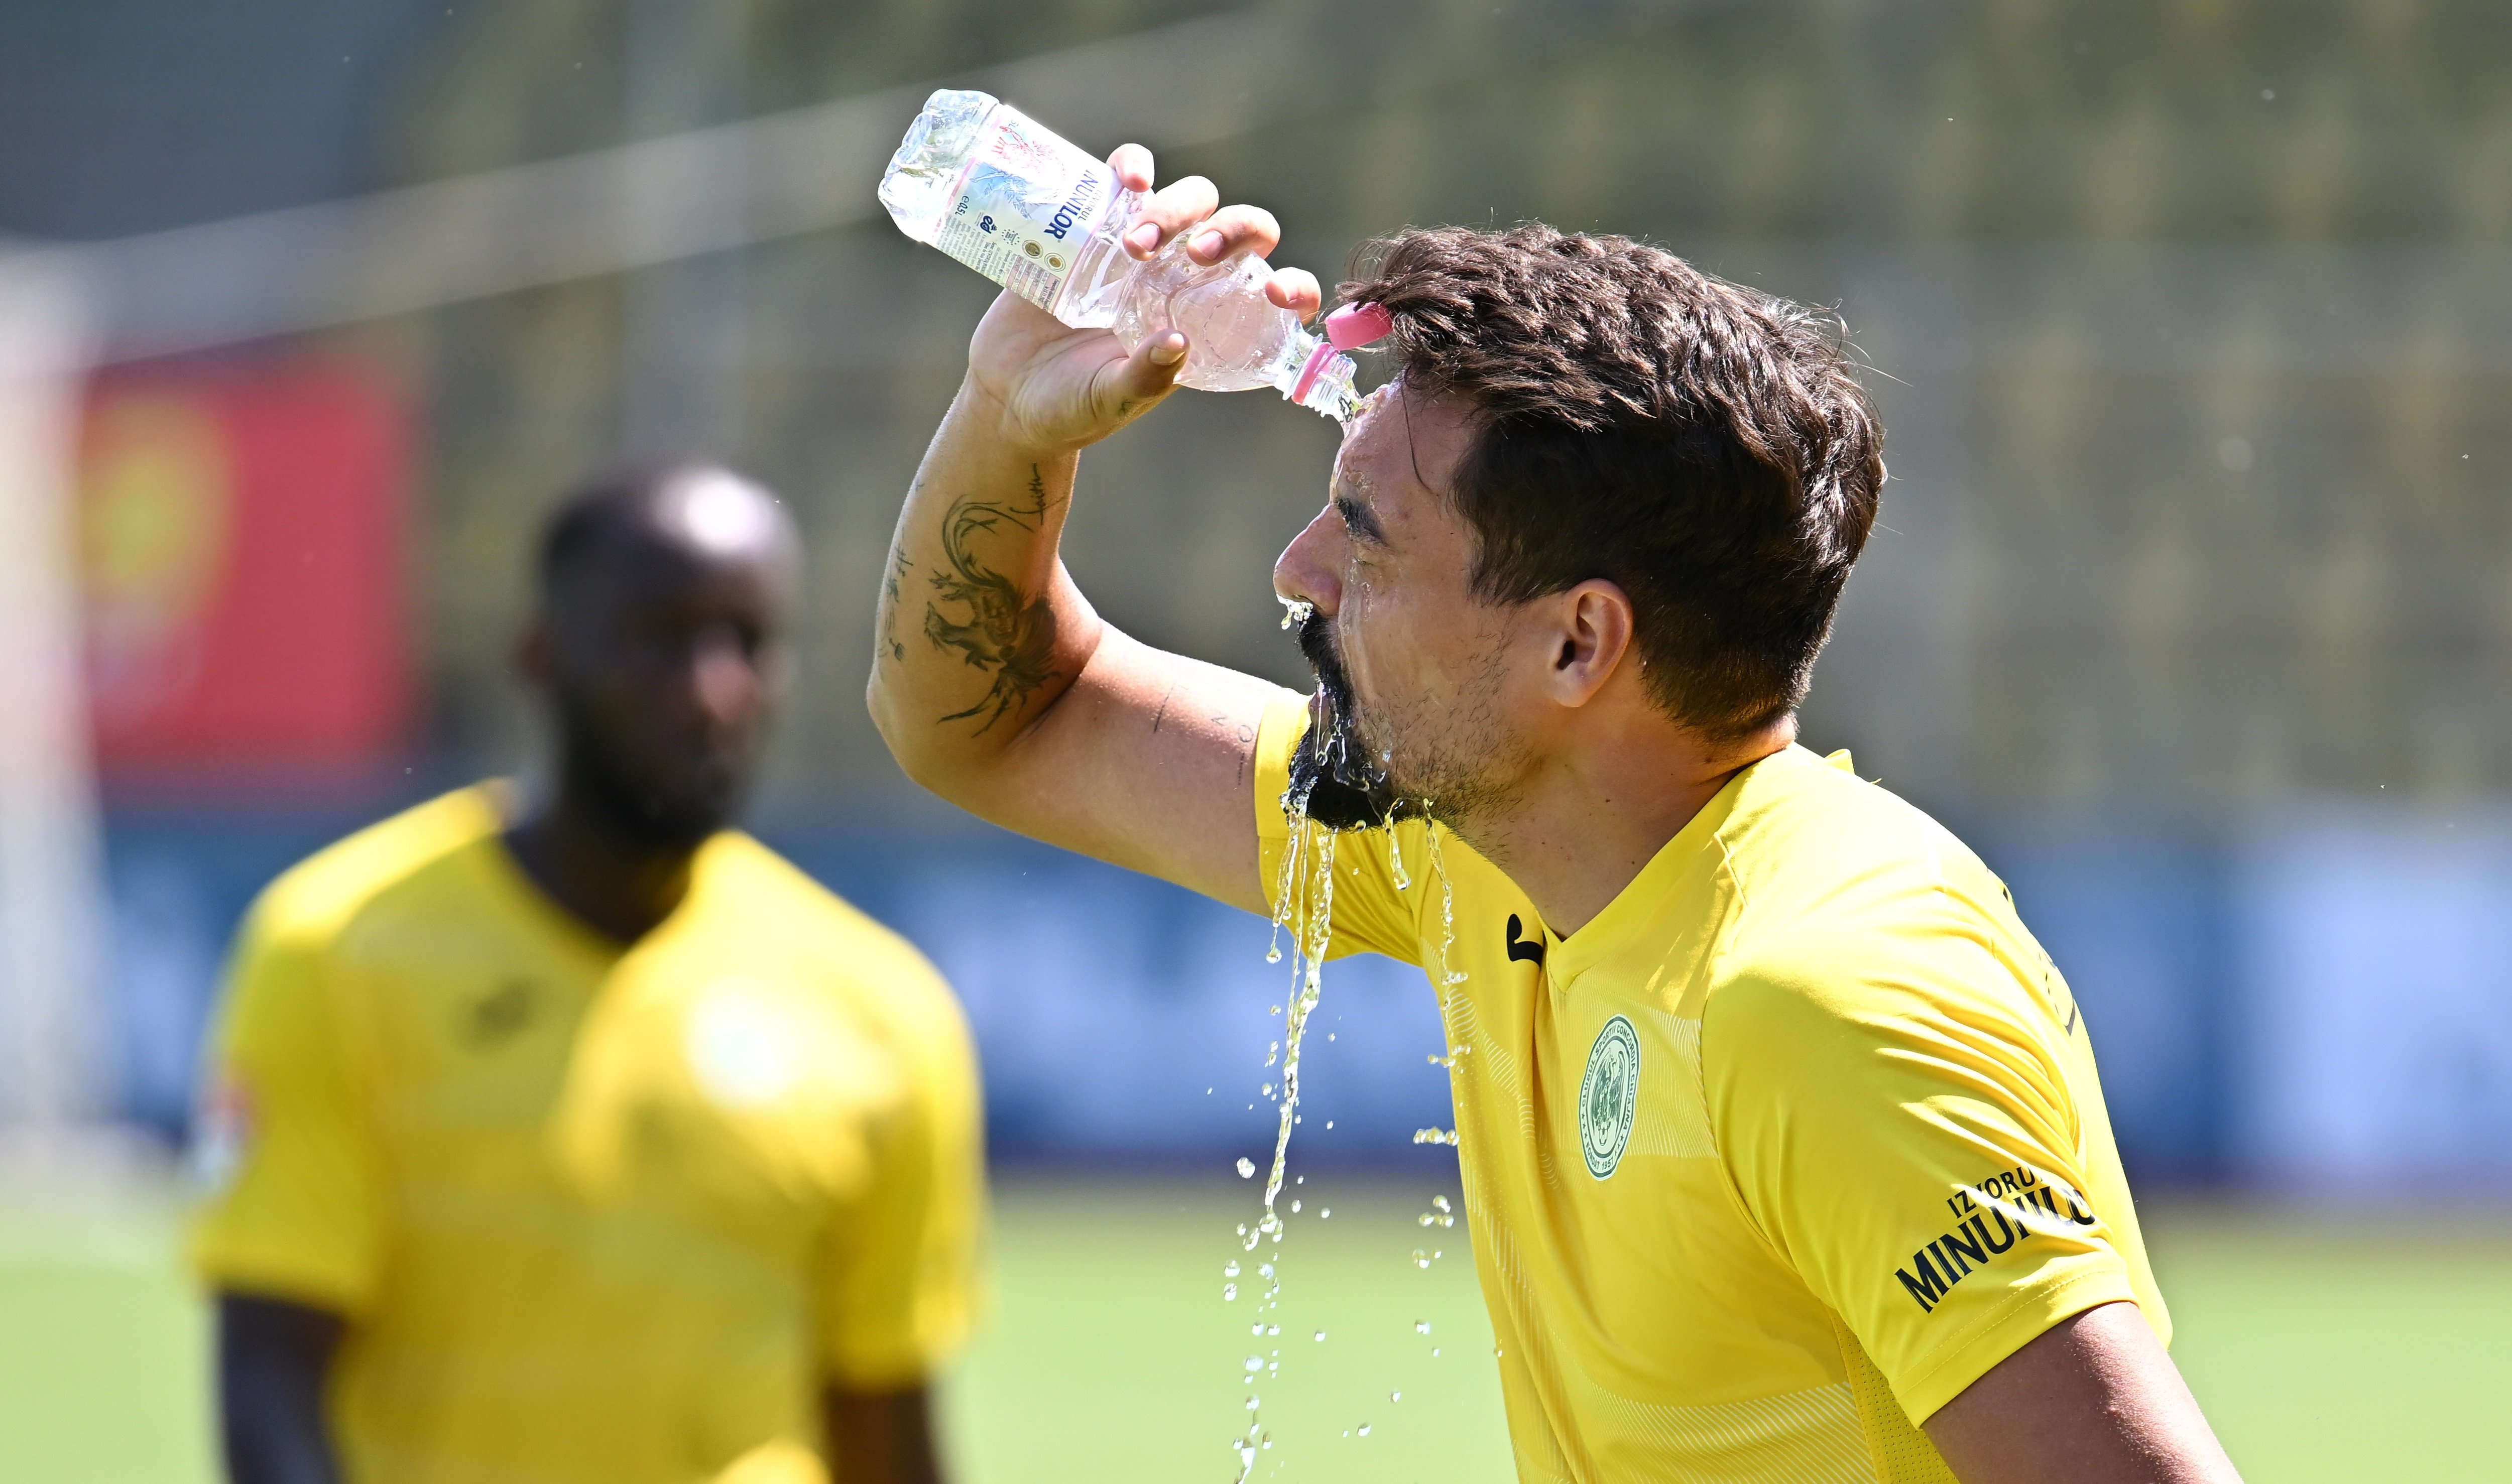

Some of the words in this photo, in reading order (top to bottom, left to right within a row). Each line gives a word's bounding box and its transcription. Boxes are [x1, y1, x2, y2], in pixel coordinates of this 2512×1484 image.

[1078, 189, 1103, 220] IZVORUL
[1595, 1024, 1616, 1056] SPORTIV
[1616, 1024, 1635, 1071] CONCORDIA
[1582, 1058, 1596, 1107] CLUBUL
[1623, 1074, 1635, 1130] CHIAJNA
[1586, 1141, 1600, 1170] FONDAT
[1601, 1157, 1613, 1170] 1957
